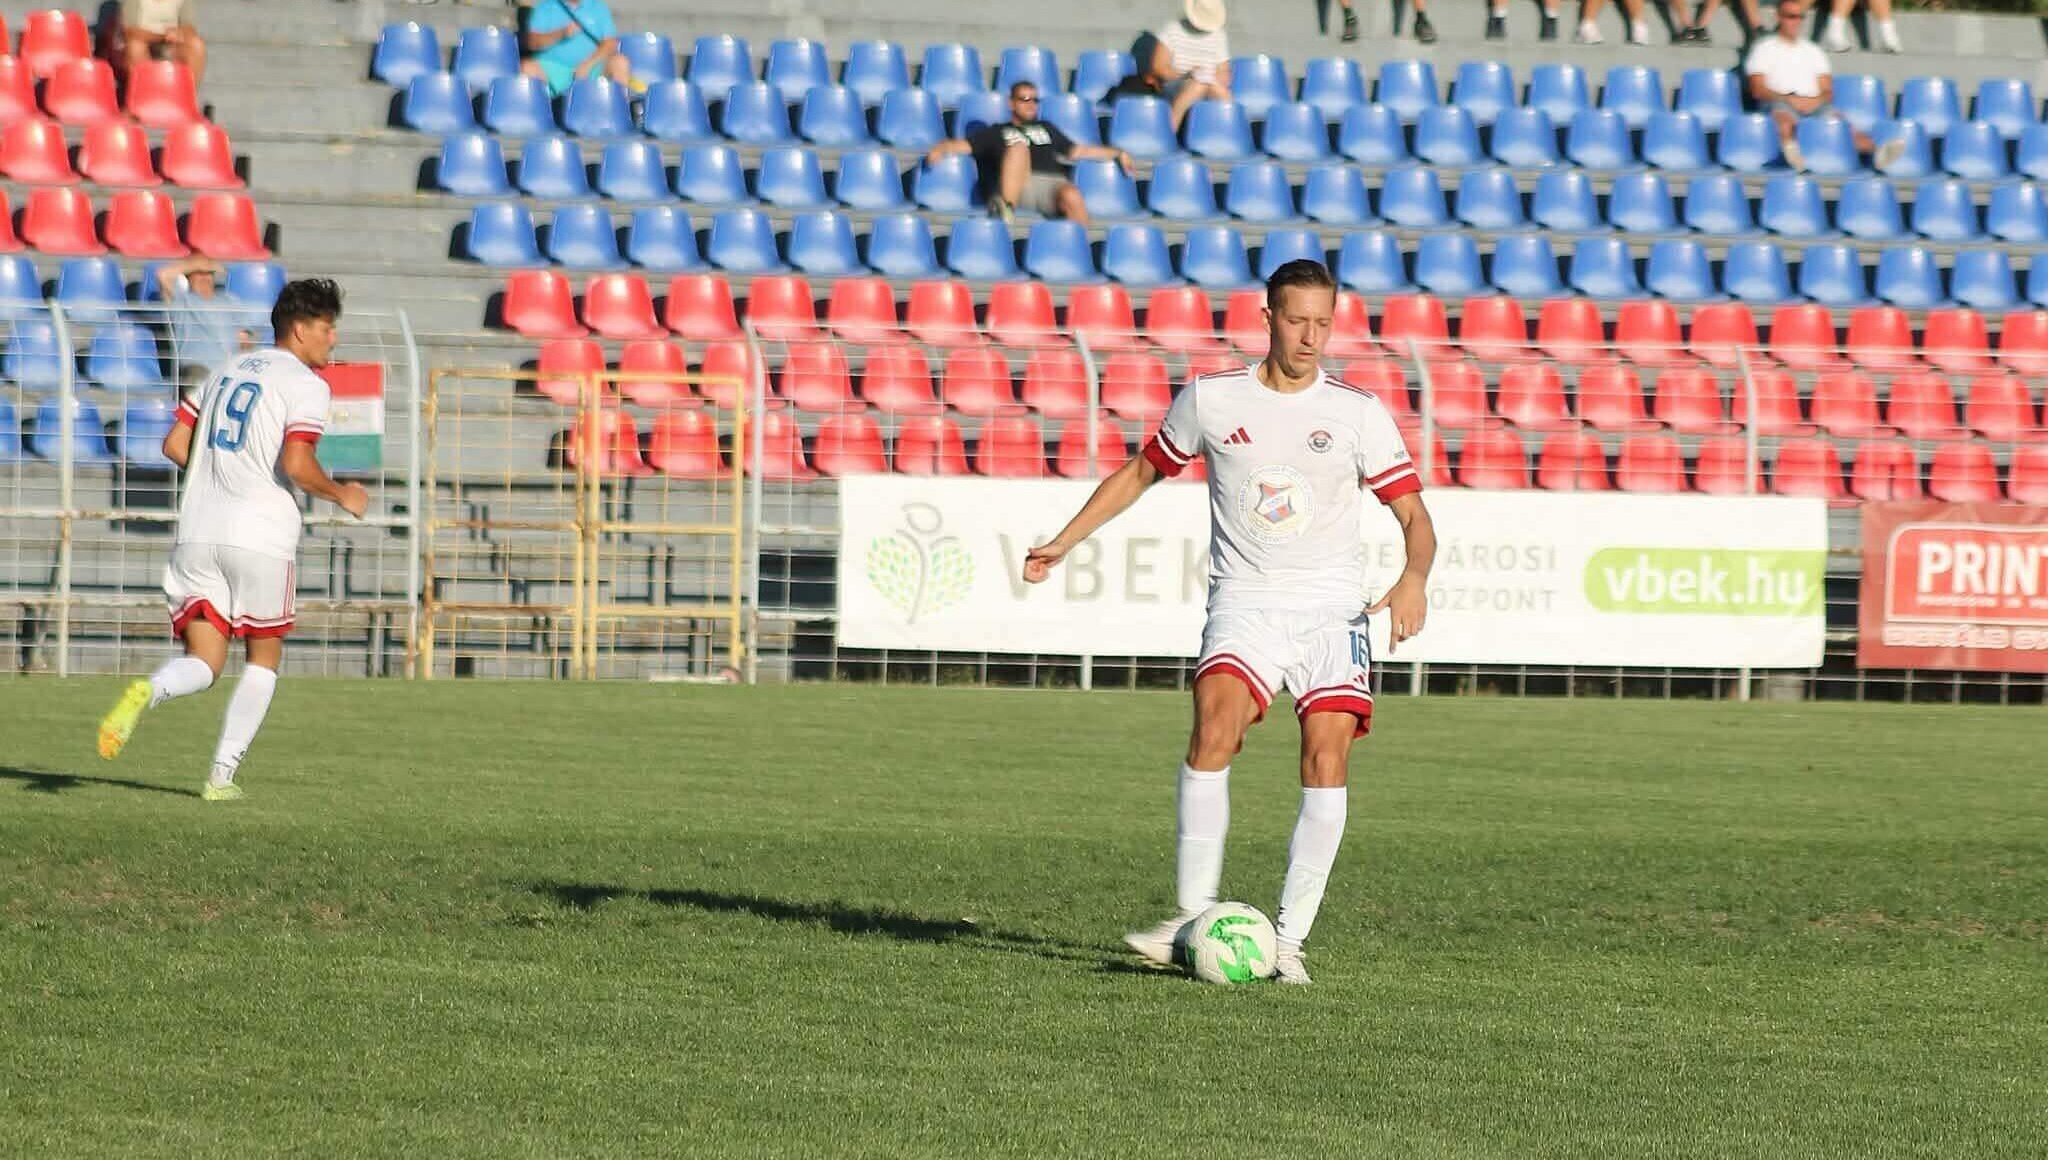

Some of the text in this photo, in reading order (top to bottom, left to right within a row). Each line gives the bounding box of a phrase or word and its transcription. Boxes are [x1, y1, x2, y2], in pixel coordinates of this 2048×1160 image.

[208, 376, 264, 453] 19
[1359, 537, 1557, 571] BEÁROSI
[1602, 553, 1808, 605] vbek.hu
[1349, 630, 1369, 669] 16
